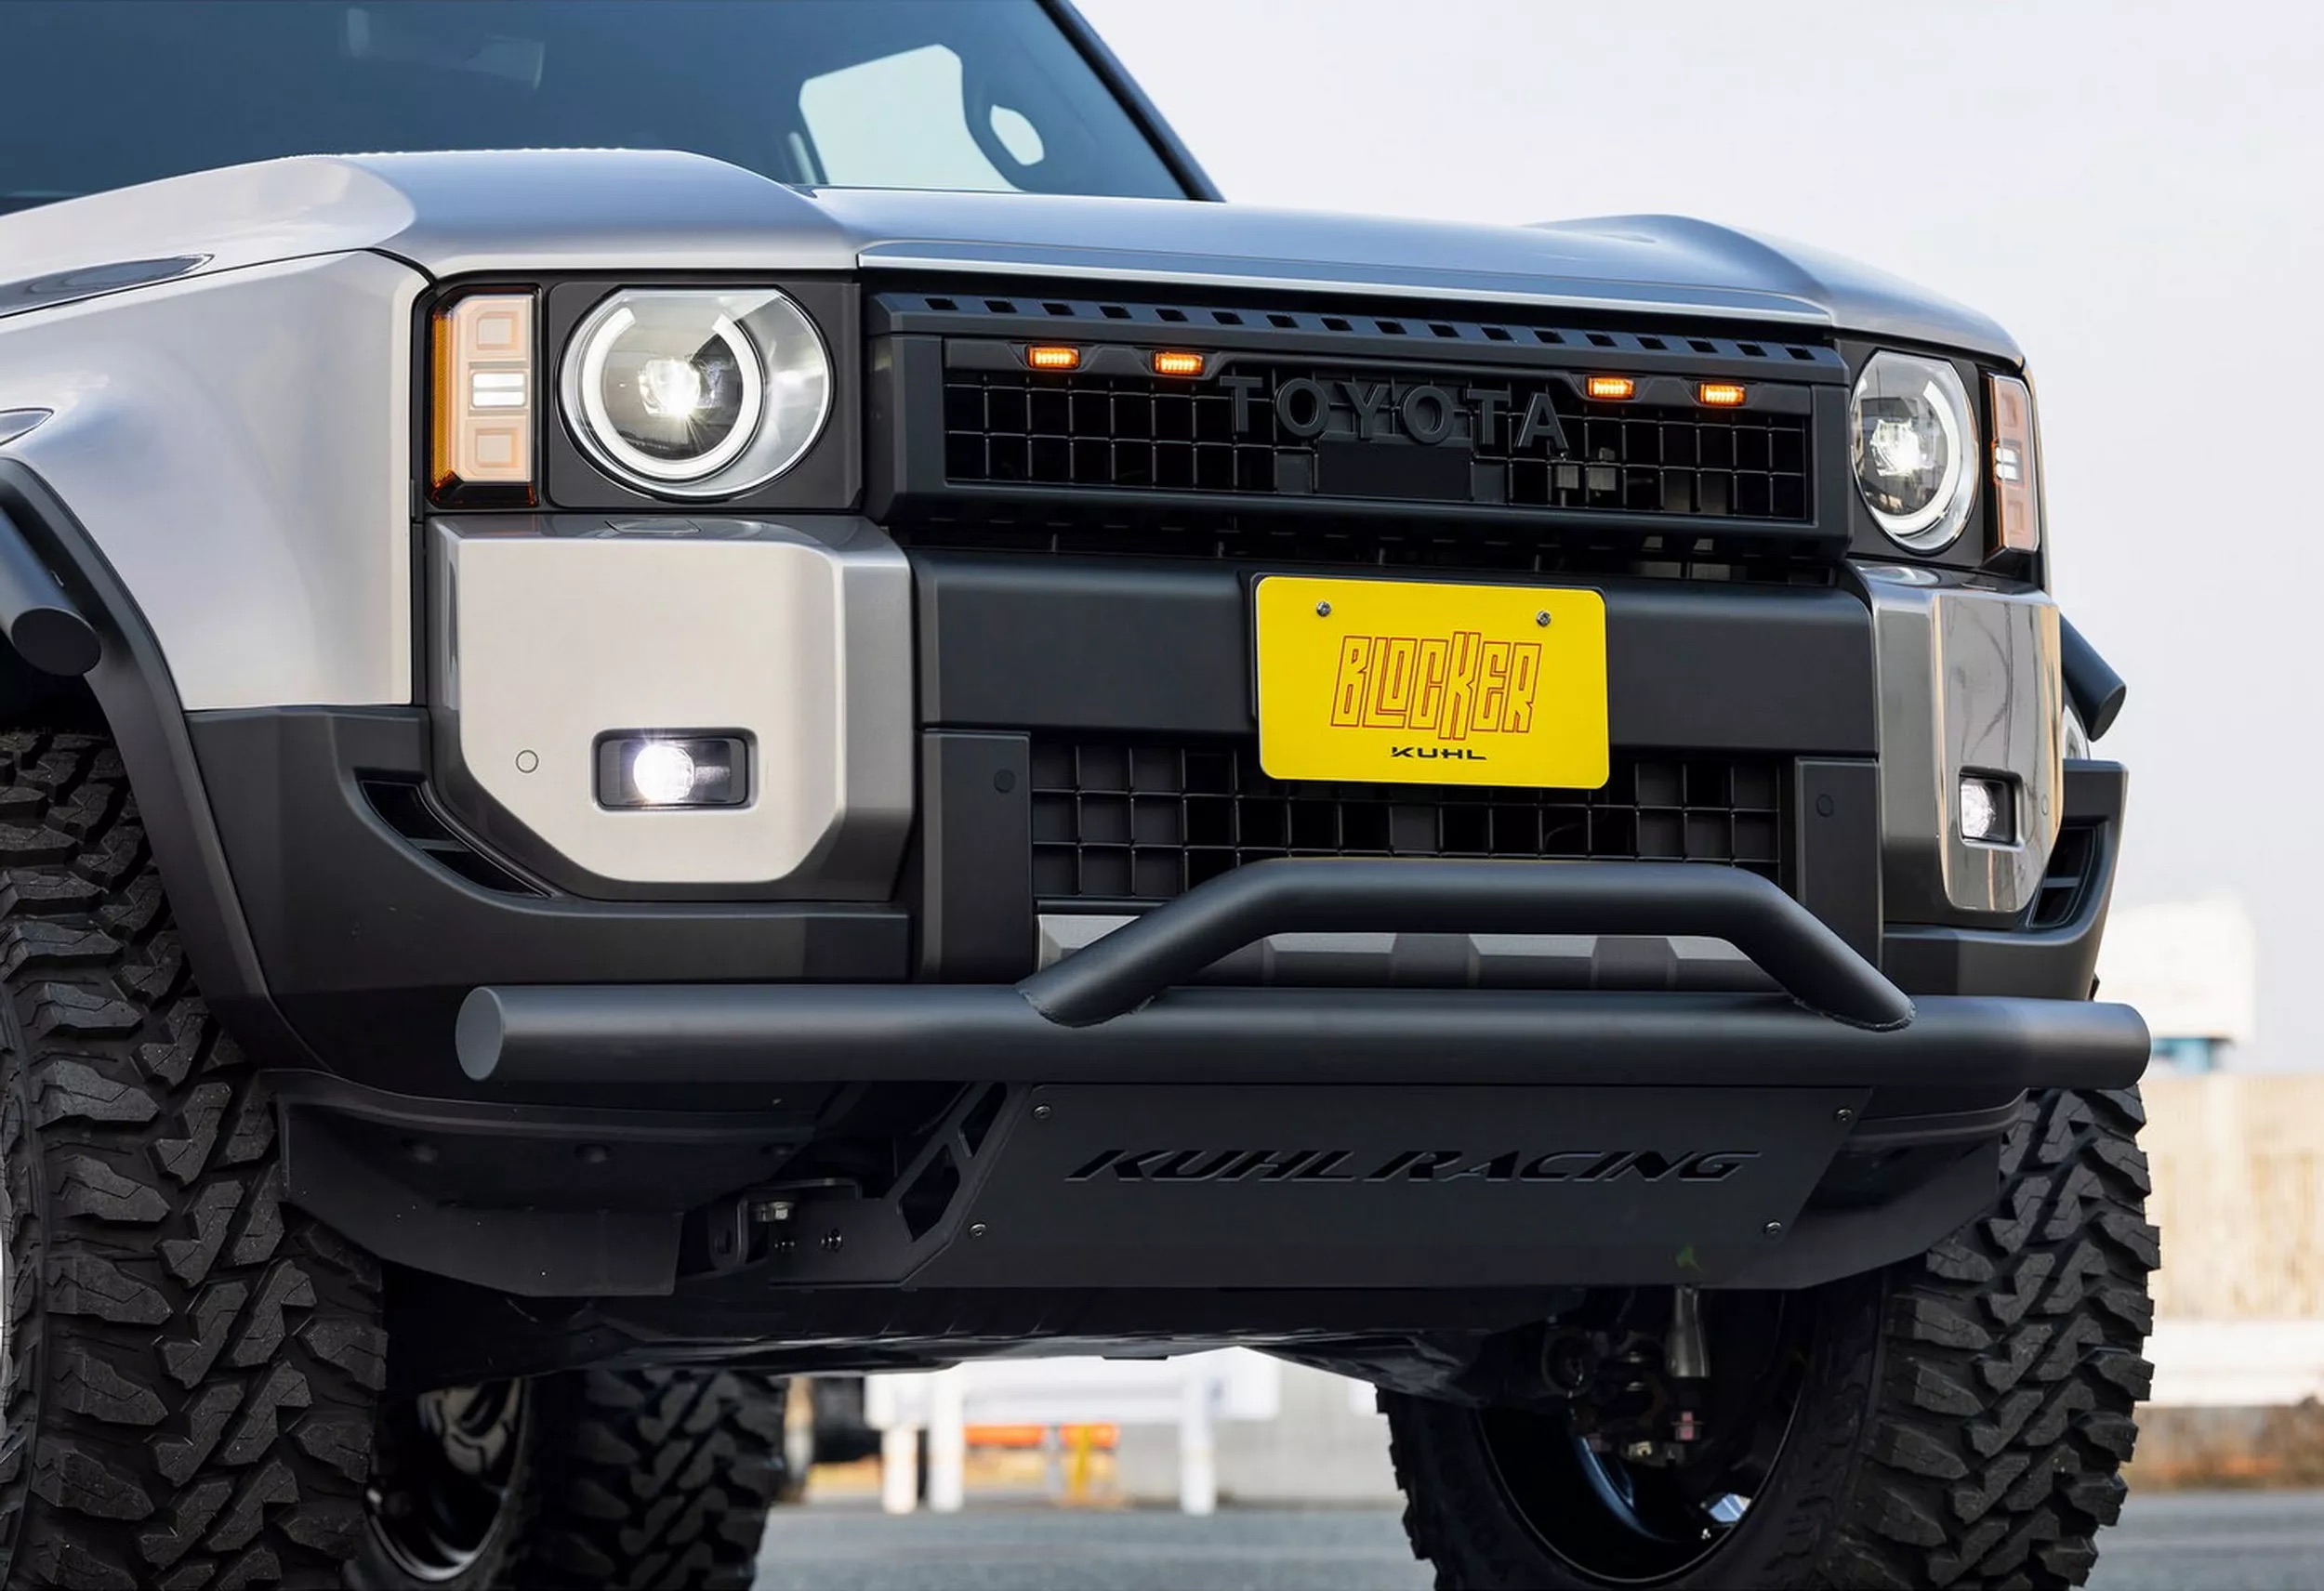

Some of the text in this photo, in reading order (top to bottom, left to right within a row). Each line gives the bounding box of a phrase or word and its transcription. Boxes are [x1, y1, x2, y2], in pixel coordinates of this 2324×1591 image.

[1220, 375, 1569, 450] TOYOTA
[1330, 631, 1542, 741] BLOCKER
[1392, 746, 1487, 760] KUHL
[1064, 1150, 1762, 1181] KUHL RACING
